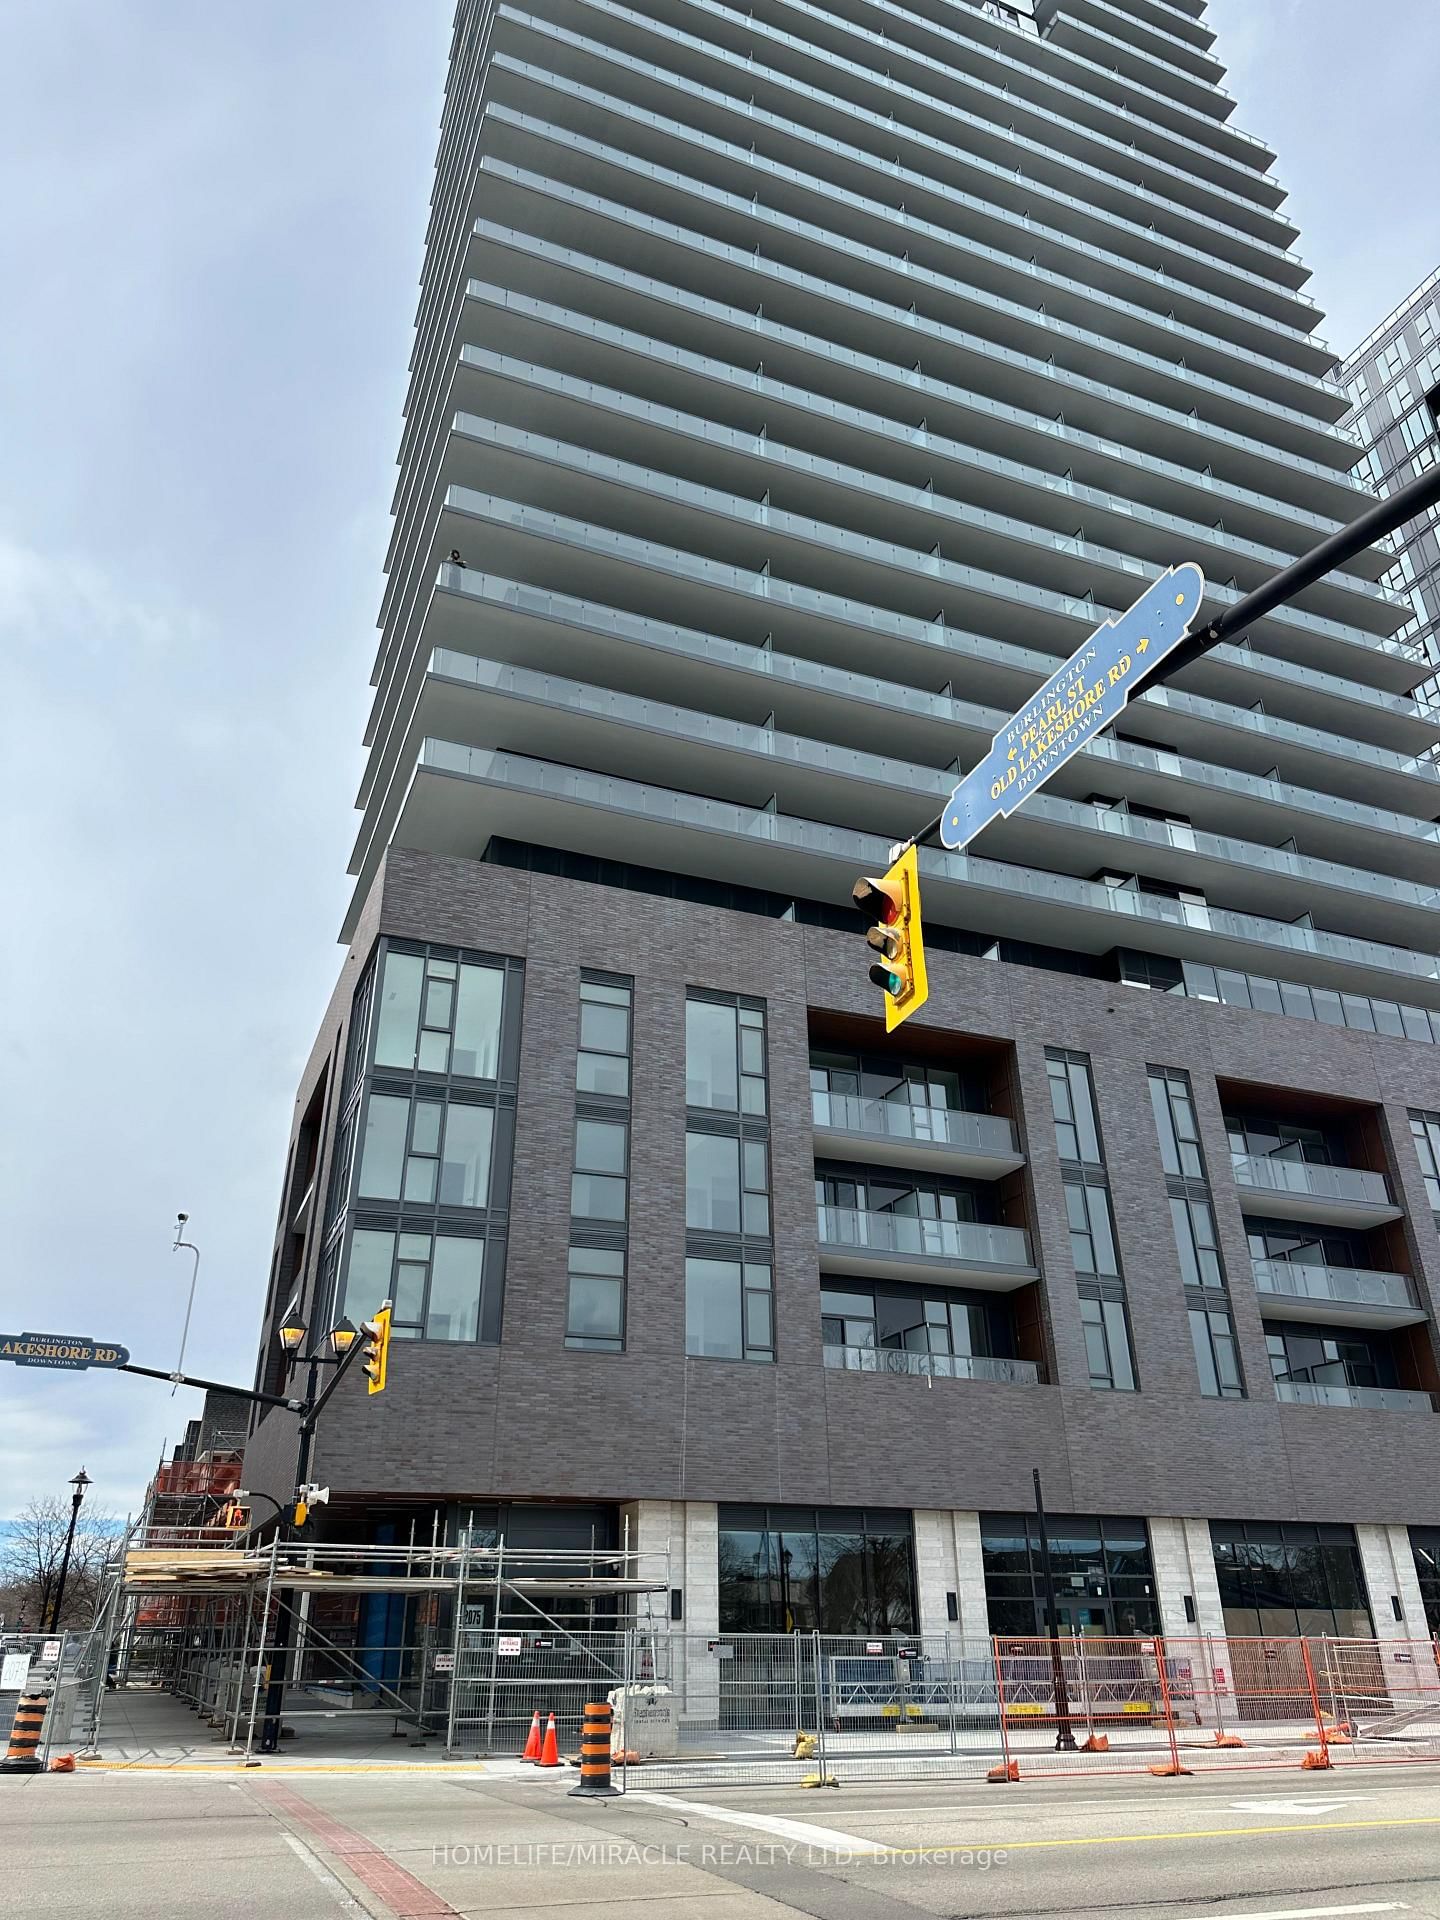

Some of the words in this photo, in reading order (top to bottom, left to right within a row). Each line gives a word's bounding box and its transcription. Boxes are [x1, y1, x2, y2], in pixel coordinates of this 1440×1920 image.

[1006, 646, 1097, 744] BURLINGTON
[1020, 698, 1067, 752] PEARL
[1067, 675, 1086, 705] ST
[990, 766, 1017, 800] OLD
[1018, 678, 1107, 774] LAKESHORE
[1106, 654, 1132, 688] RD
[1016, 703, 1104, 792] DOWNTOWN
[0, 1341, 92, 1360] AKESHORE
[94, 1348, 118, 1362] RD
[30, 1336, 83, 1346] BURLINGTON
[27, 1357, 78, 1366] DOWNTOWN
[464, 1609, 481, 1625] 2075
[3, 1660, 26, 1682] 2075
